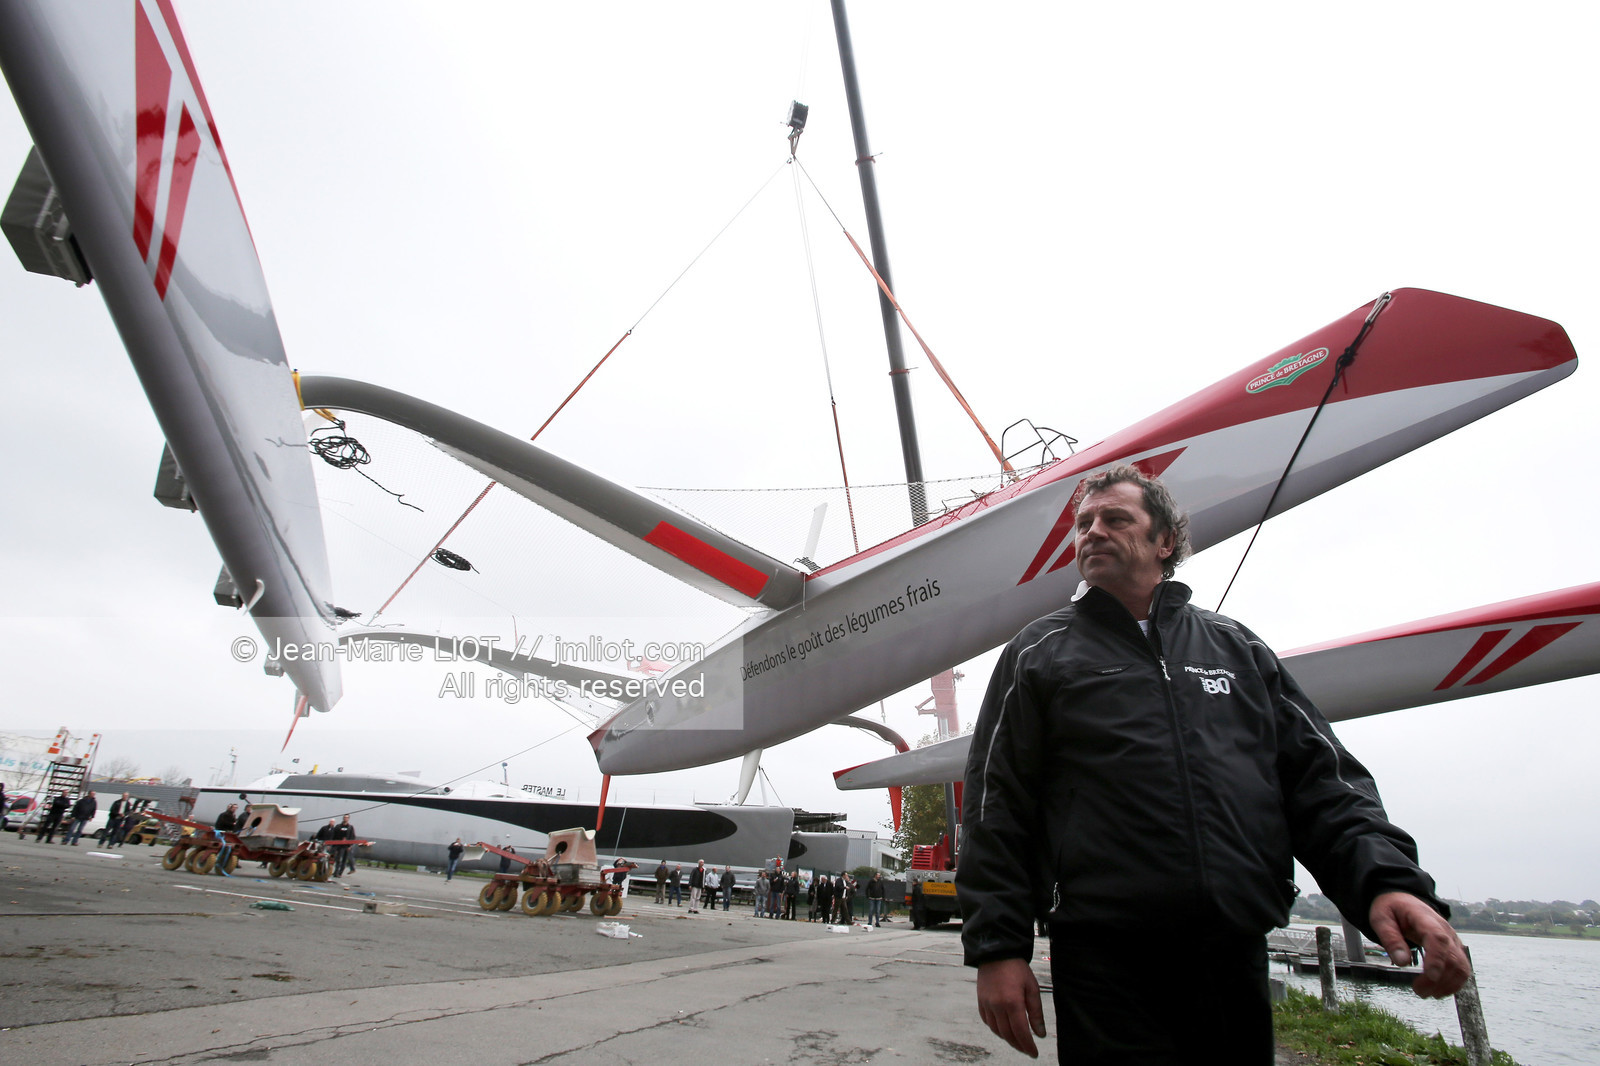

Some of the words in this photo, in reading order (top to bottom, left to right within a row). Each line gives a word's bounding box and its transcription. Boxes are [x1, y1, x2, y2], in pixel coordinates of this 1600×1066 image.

[1249, 373, 1275, 390] PRINCE
[1284, 350, 1325, 374] BRETAGNE
[739, 650, 787, 681] Défendons
[787, 644, 797, 661] le
[797, 632, 824, 660] goût
[824, 623, 846, 644] des
[846, 596, 905, 634] légumes
[906, 578, 941, 607] frais
[1205, 677, 1231, 695] 80
